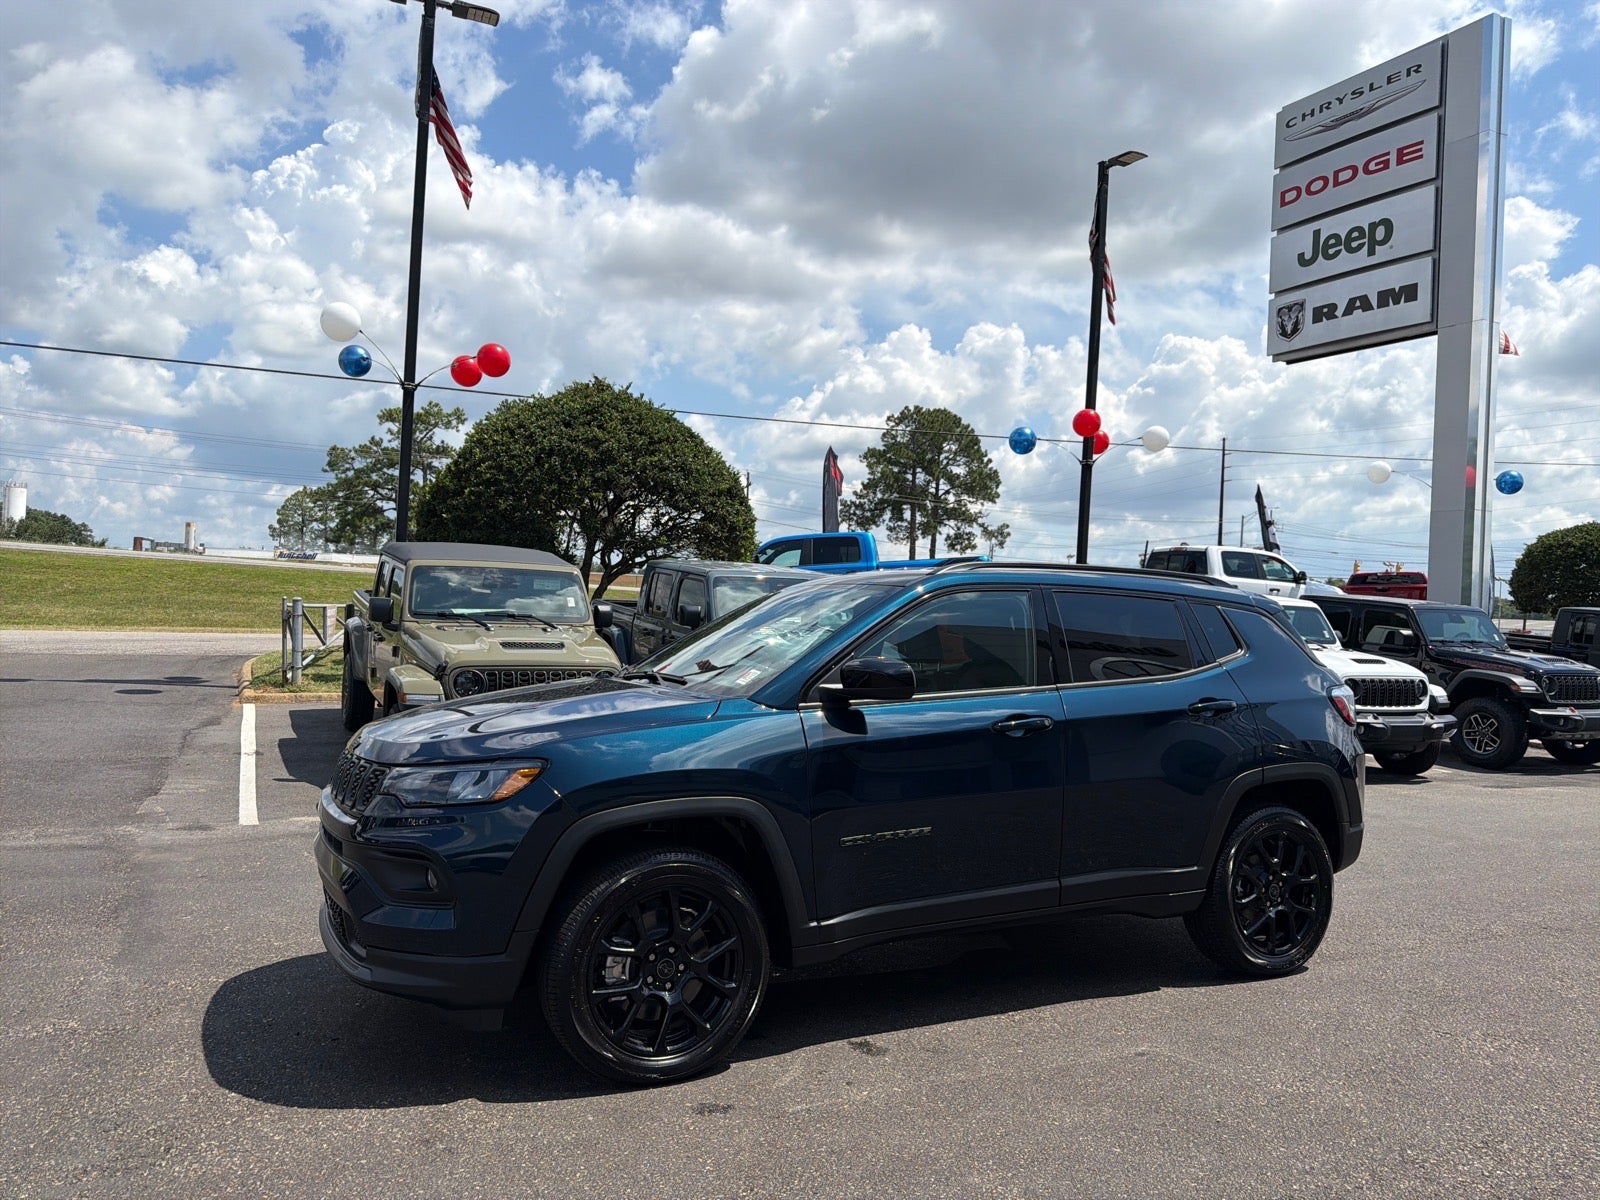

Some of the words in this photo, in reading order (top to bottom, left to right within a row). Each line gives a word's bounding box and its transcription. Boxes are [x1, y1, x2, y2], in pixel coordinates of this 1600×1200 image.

[1285, 63, 1423, 129] CHRYSLER
[1279, 140, 1424, 208] DODGE
[1297, 217, 1394, 268] Jeep
[1312, 282, 1418, 325] RAM
